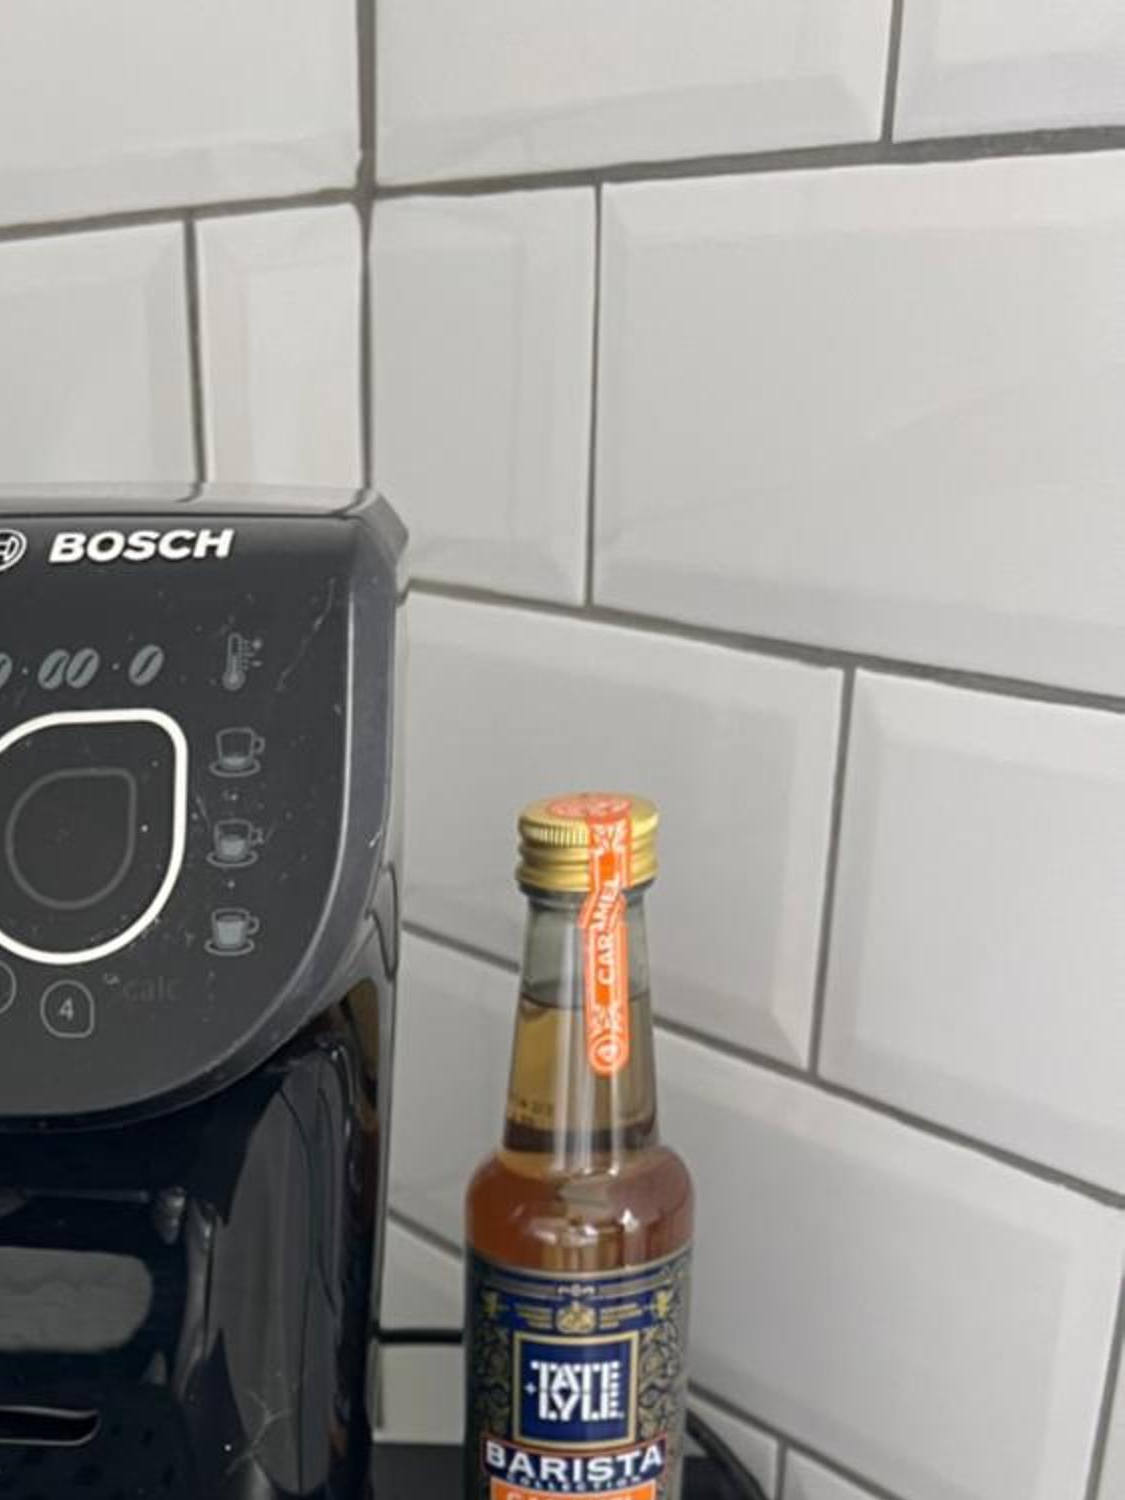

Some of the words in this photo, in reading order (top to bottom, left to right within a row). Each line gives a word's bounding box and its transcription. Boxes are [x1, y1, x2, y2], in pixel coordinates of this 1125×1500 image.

[49, 530, 235, 562] BOSCH
[58, 996, 75, 1021] 4
[530, 1360, 621, 1393] TATE
[537, 1392, 623, 1421] LYLE
[485, 1439, 663, 1483] BARISTA
